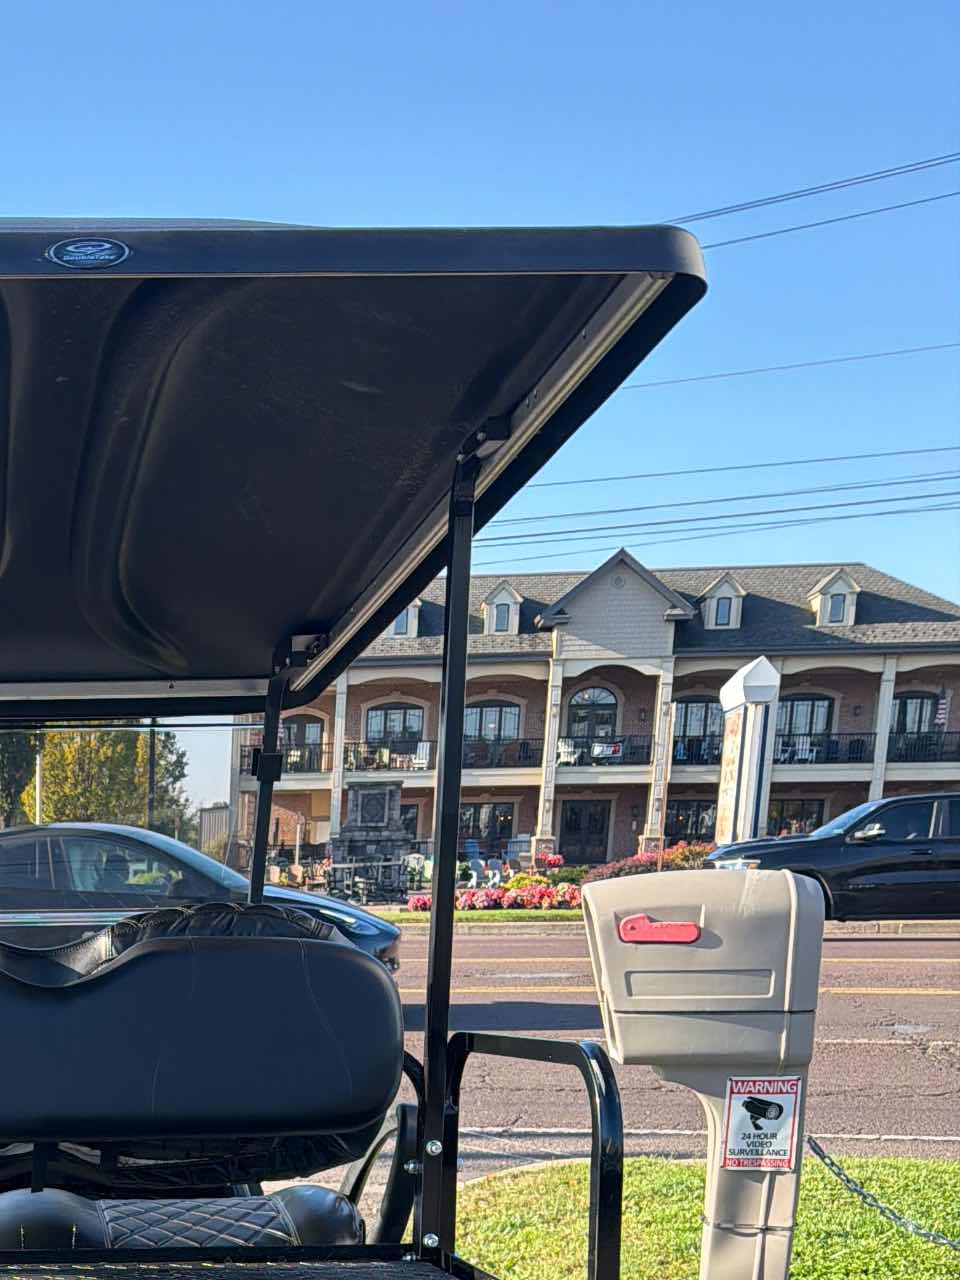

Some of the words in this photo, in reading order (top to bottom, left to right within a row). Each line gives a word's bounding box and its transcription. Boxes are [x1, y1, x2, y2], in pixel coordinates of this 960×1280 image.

[732, 1081, 797, 1092] WARNING
[742, 1132, 751, 1140] 24
[753, 1132, 777, 1140] HOUR
[746, 1140, 772, 1148] VIDEO
[728, 1148, 788, 1156] SURVEILLANCE
[726, 1159, 738, 1167] NO
[740, 1159, 788, 1168] TRESPASSING
